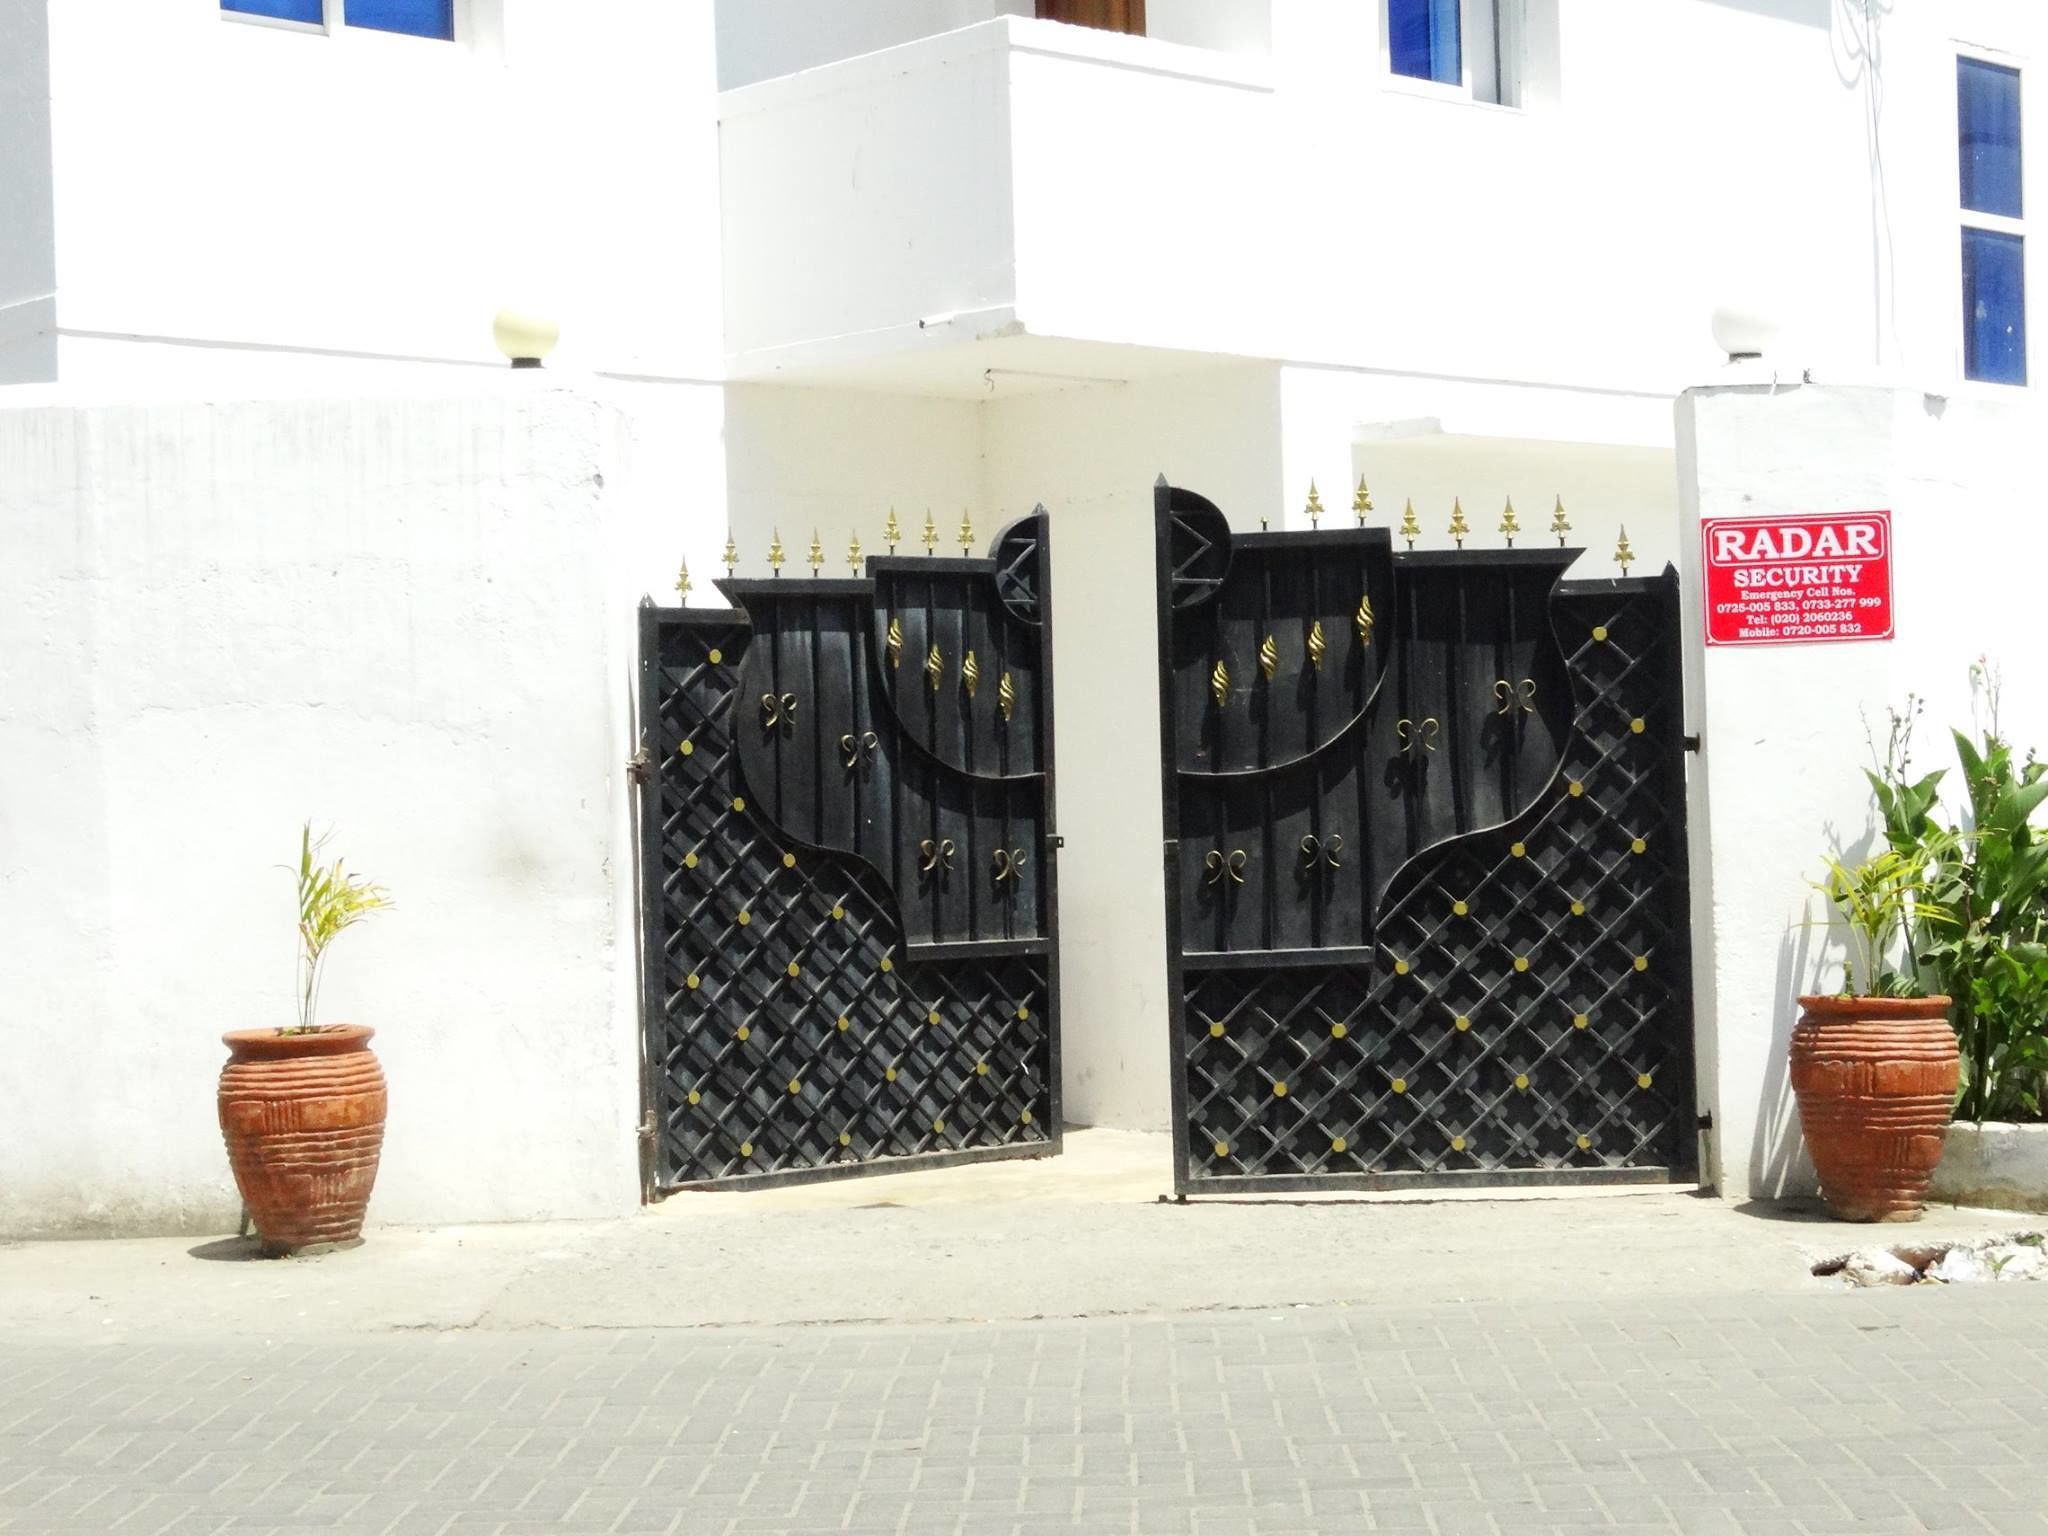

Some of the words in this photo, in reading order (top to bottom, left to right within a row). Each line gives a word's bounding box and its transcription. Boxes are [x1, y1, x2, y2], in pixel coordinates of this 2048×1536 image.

[1714, 524, 1879, 561] RADAR
[1734, 565, 1863, 587] SECURITY
[1741, 589, 1804, 601] Emergency
[1807, 588, 1829, 596] Cell
[1832, 587, 1855, 596] Nos.
[1717, 602, 1770, 613] 0725-005
[1775, 601, 1799, 611] 833,
[1803, 599, 1856, 610] 0733-277
[1860, 598, 1881, 607] 999
[1746, 615, 1768, 625] Tel:
[1771, 614, 1799, 625] (020)
[1803, 612, 1853, 622] 2060236
[1739, 627, 1779, 638] Mobile:
[1783, 625, 1836, 636] 0720-005
[1840, 624, 1861, 633] 832
